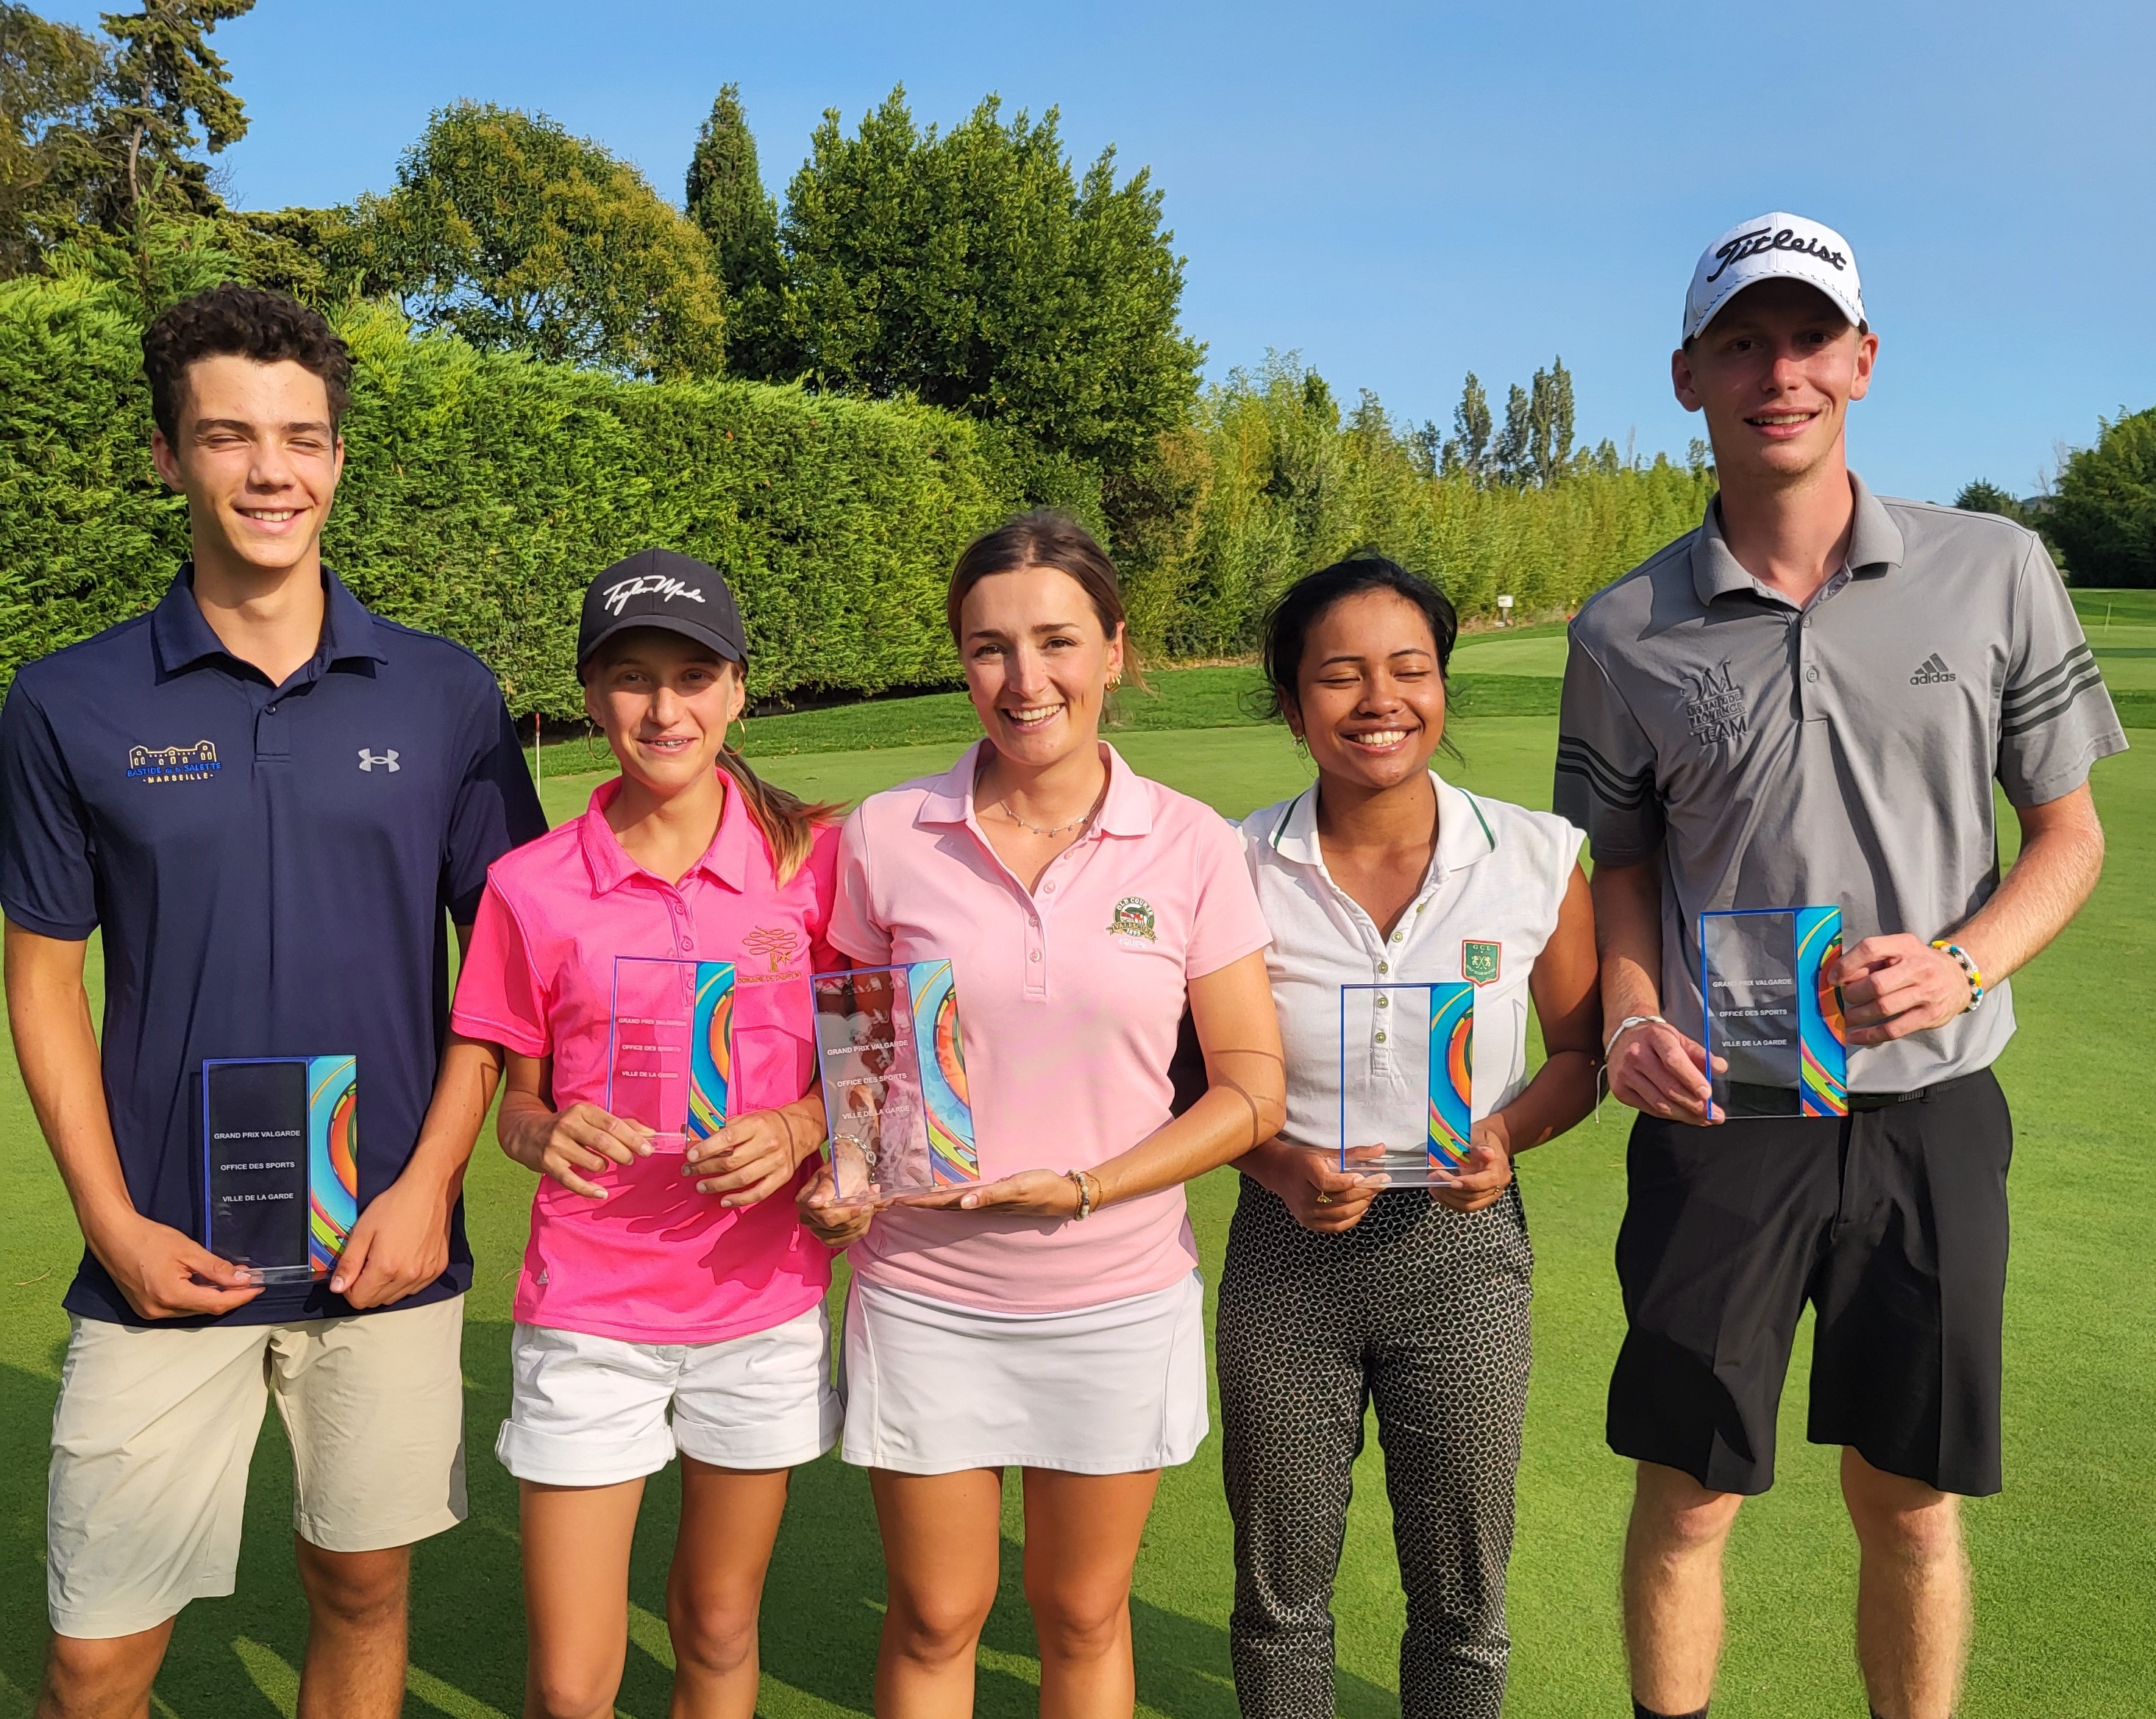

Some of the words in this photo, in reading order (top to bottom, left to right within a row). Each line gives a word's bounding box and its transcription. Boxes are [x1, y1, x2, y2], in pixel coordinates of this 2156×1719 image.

[1707, 227, 1847, 282] Titleist
[602, 574, 706, 616] TaylorMade
[1910, 672, 1956, 686] adidas
[127, 766, 162, 777] BASTIDE
[184, 762, 221, 772] SALETTE
[148, 772, 208, 783] MARSEILLE
[1117, 899, 1128, 911] OLD
[827, 1047, 852, 1056] GRAND
[871, 1040, 909, 1050] VALGARDE
[837, 1078, 862, 1087] OFFICE
[879, 1073, 907, 1082] SPORTS
[842, 1111, 862, 1120] VILLE
[885, 1106, 910, 1114] GARDE
